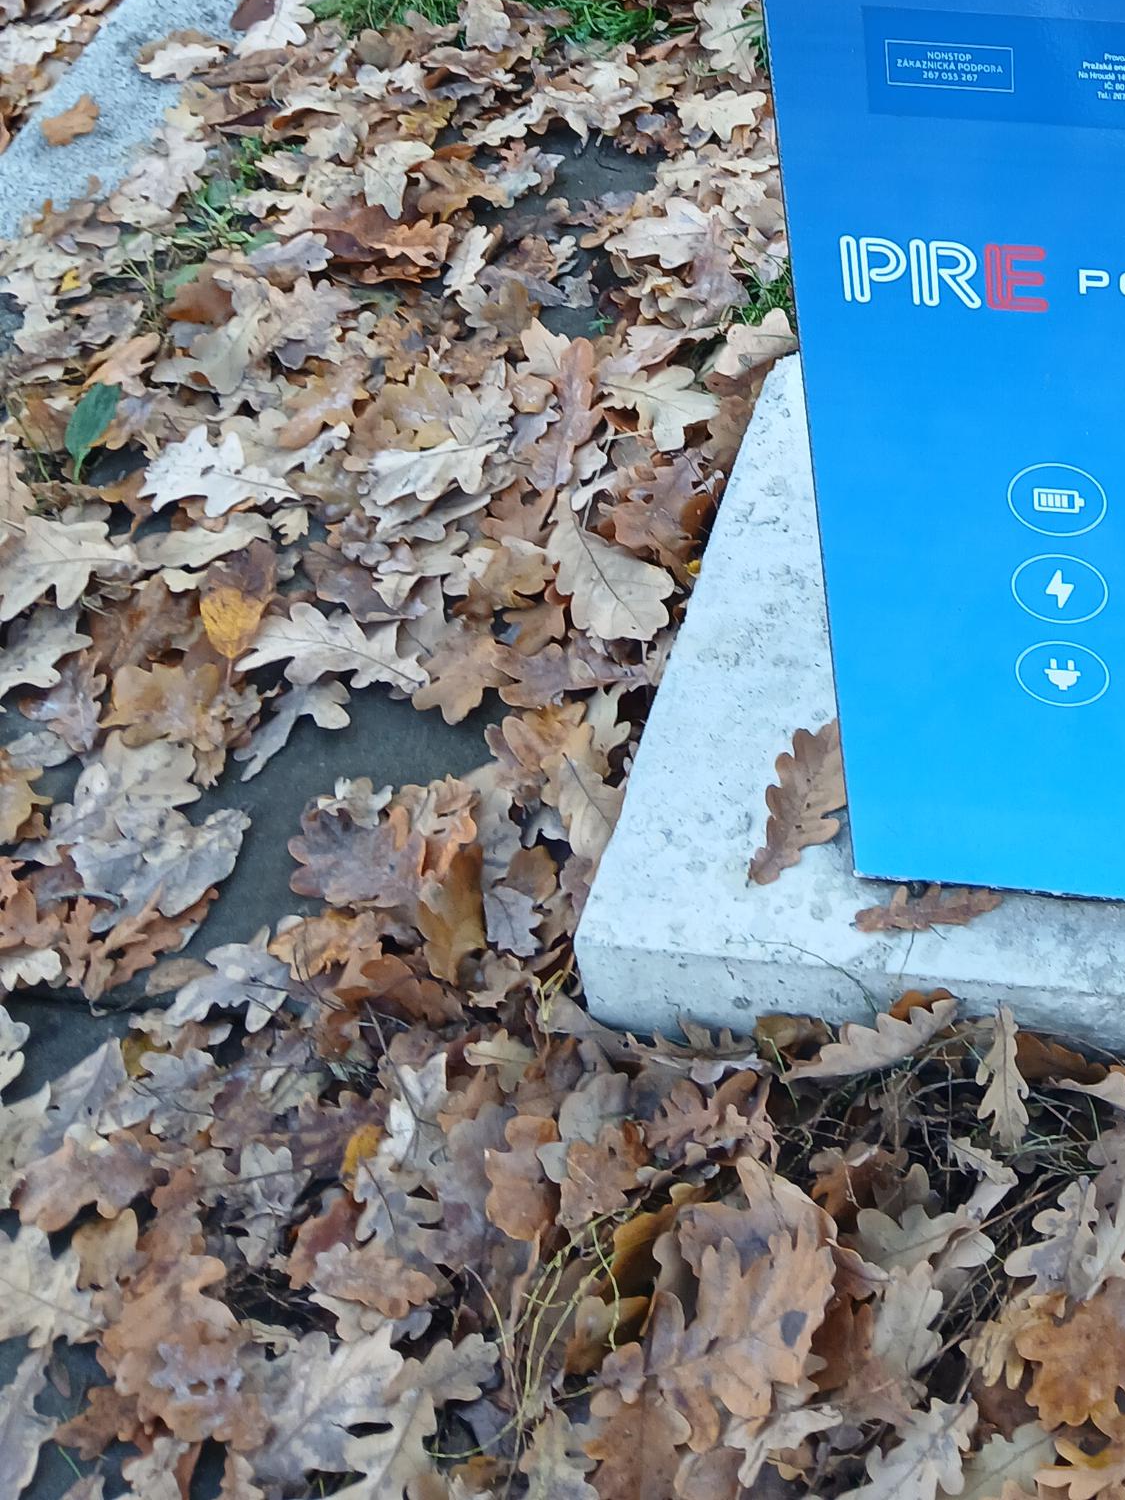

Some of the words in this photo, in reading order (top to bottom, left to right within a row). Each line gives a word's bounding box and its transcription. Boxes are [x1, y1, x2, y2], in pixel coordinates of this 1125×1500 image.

[927, 51, 972, 61] NONSTOP
[958, 63, 1003, 73] PODPORA
[839, 234, 1049, 313] PRE
